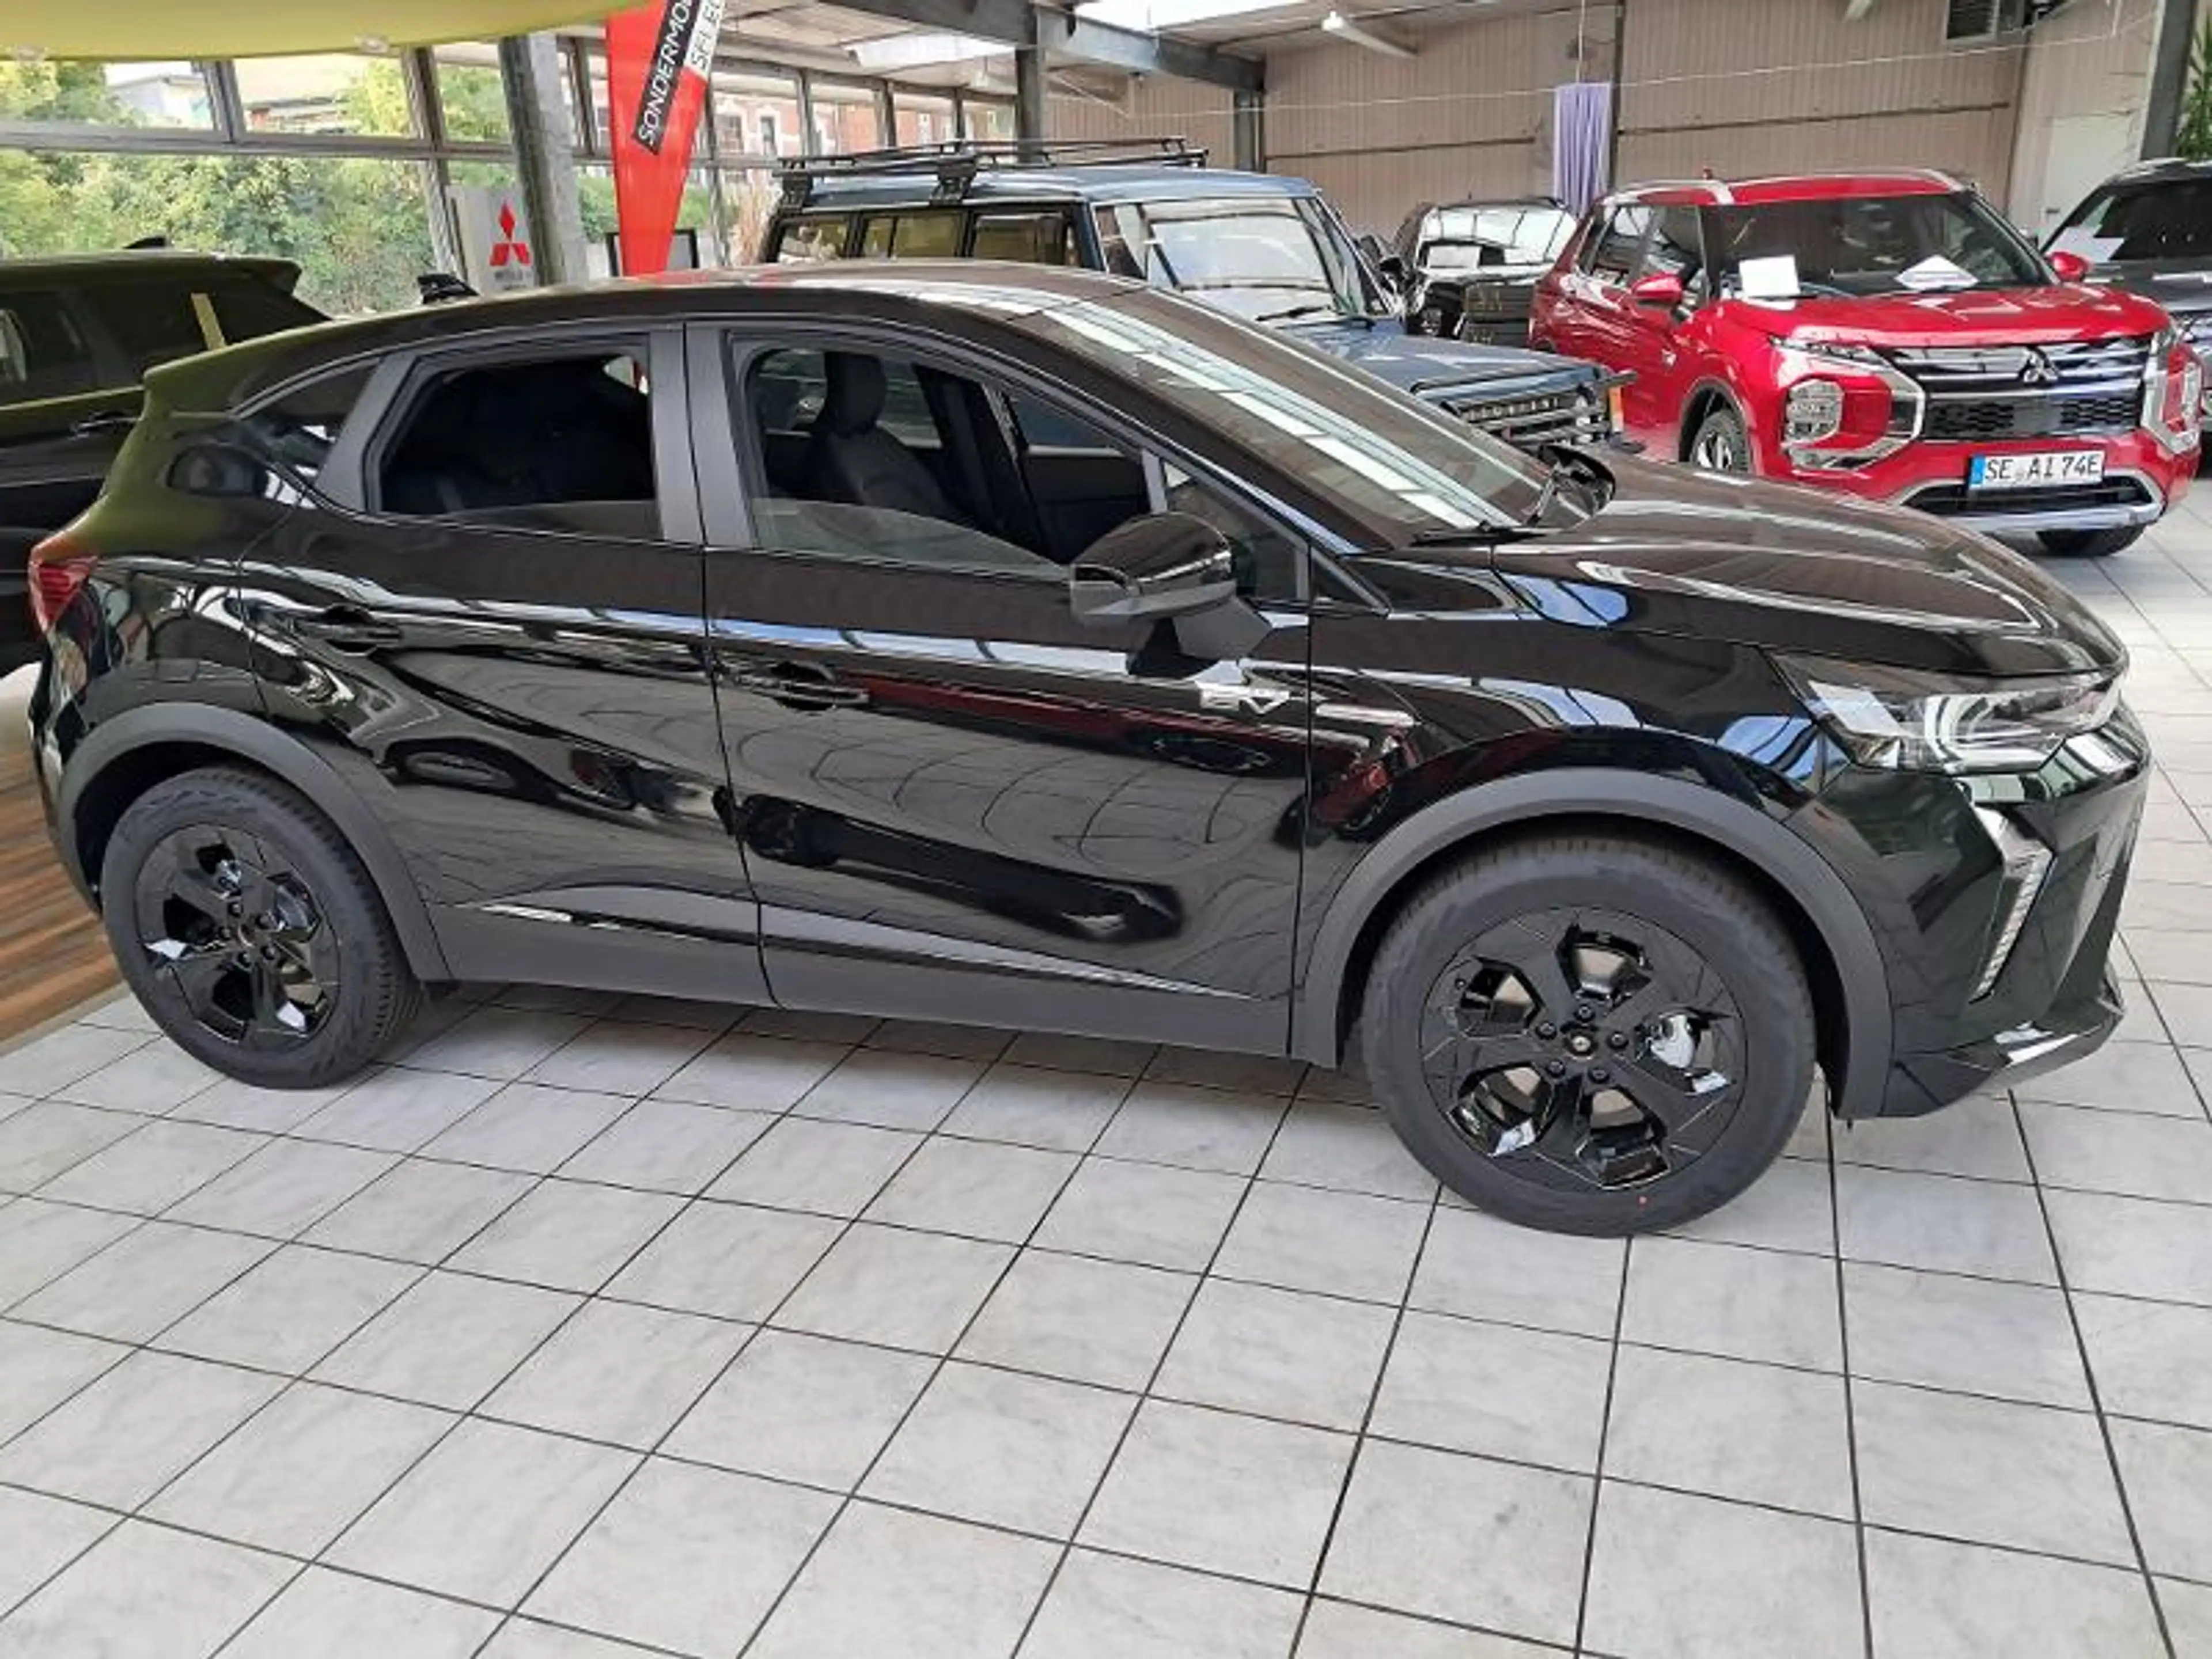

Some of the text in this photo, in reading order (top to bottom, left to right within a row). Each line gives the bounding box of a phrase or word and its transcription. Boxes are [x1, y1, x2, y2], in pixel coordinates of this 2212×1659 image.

[638, 0, 691, 146] SONDERMO
[1985, 459, 2013, 479] SE
[2062, 453, 2099, 476] 74E
